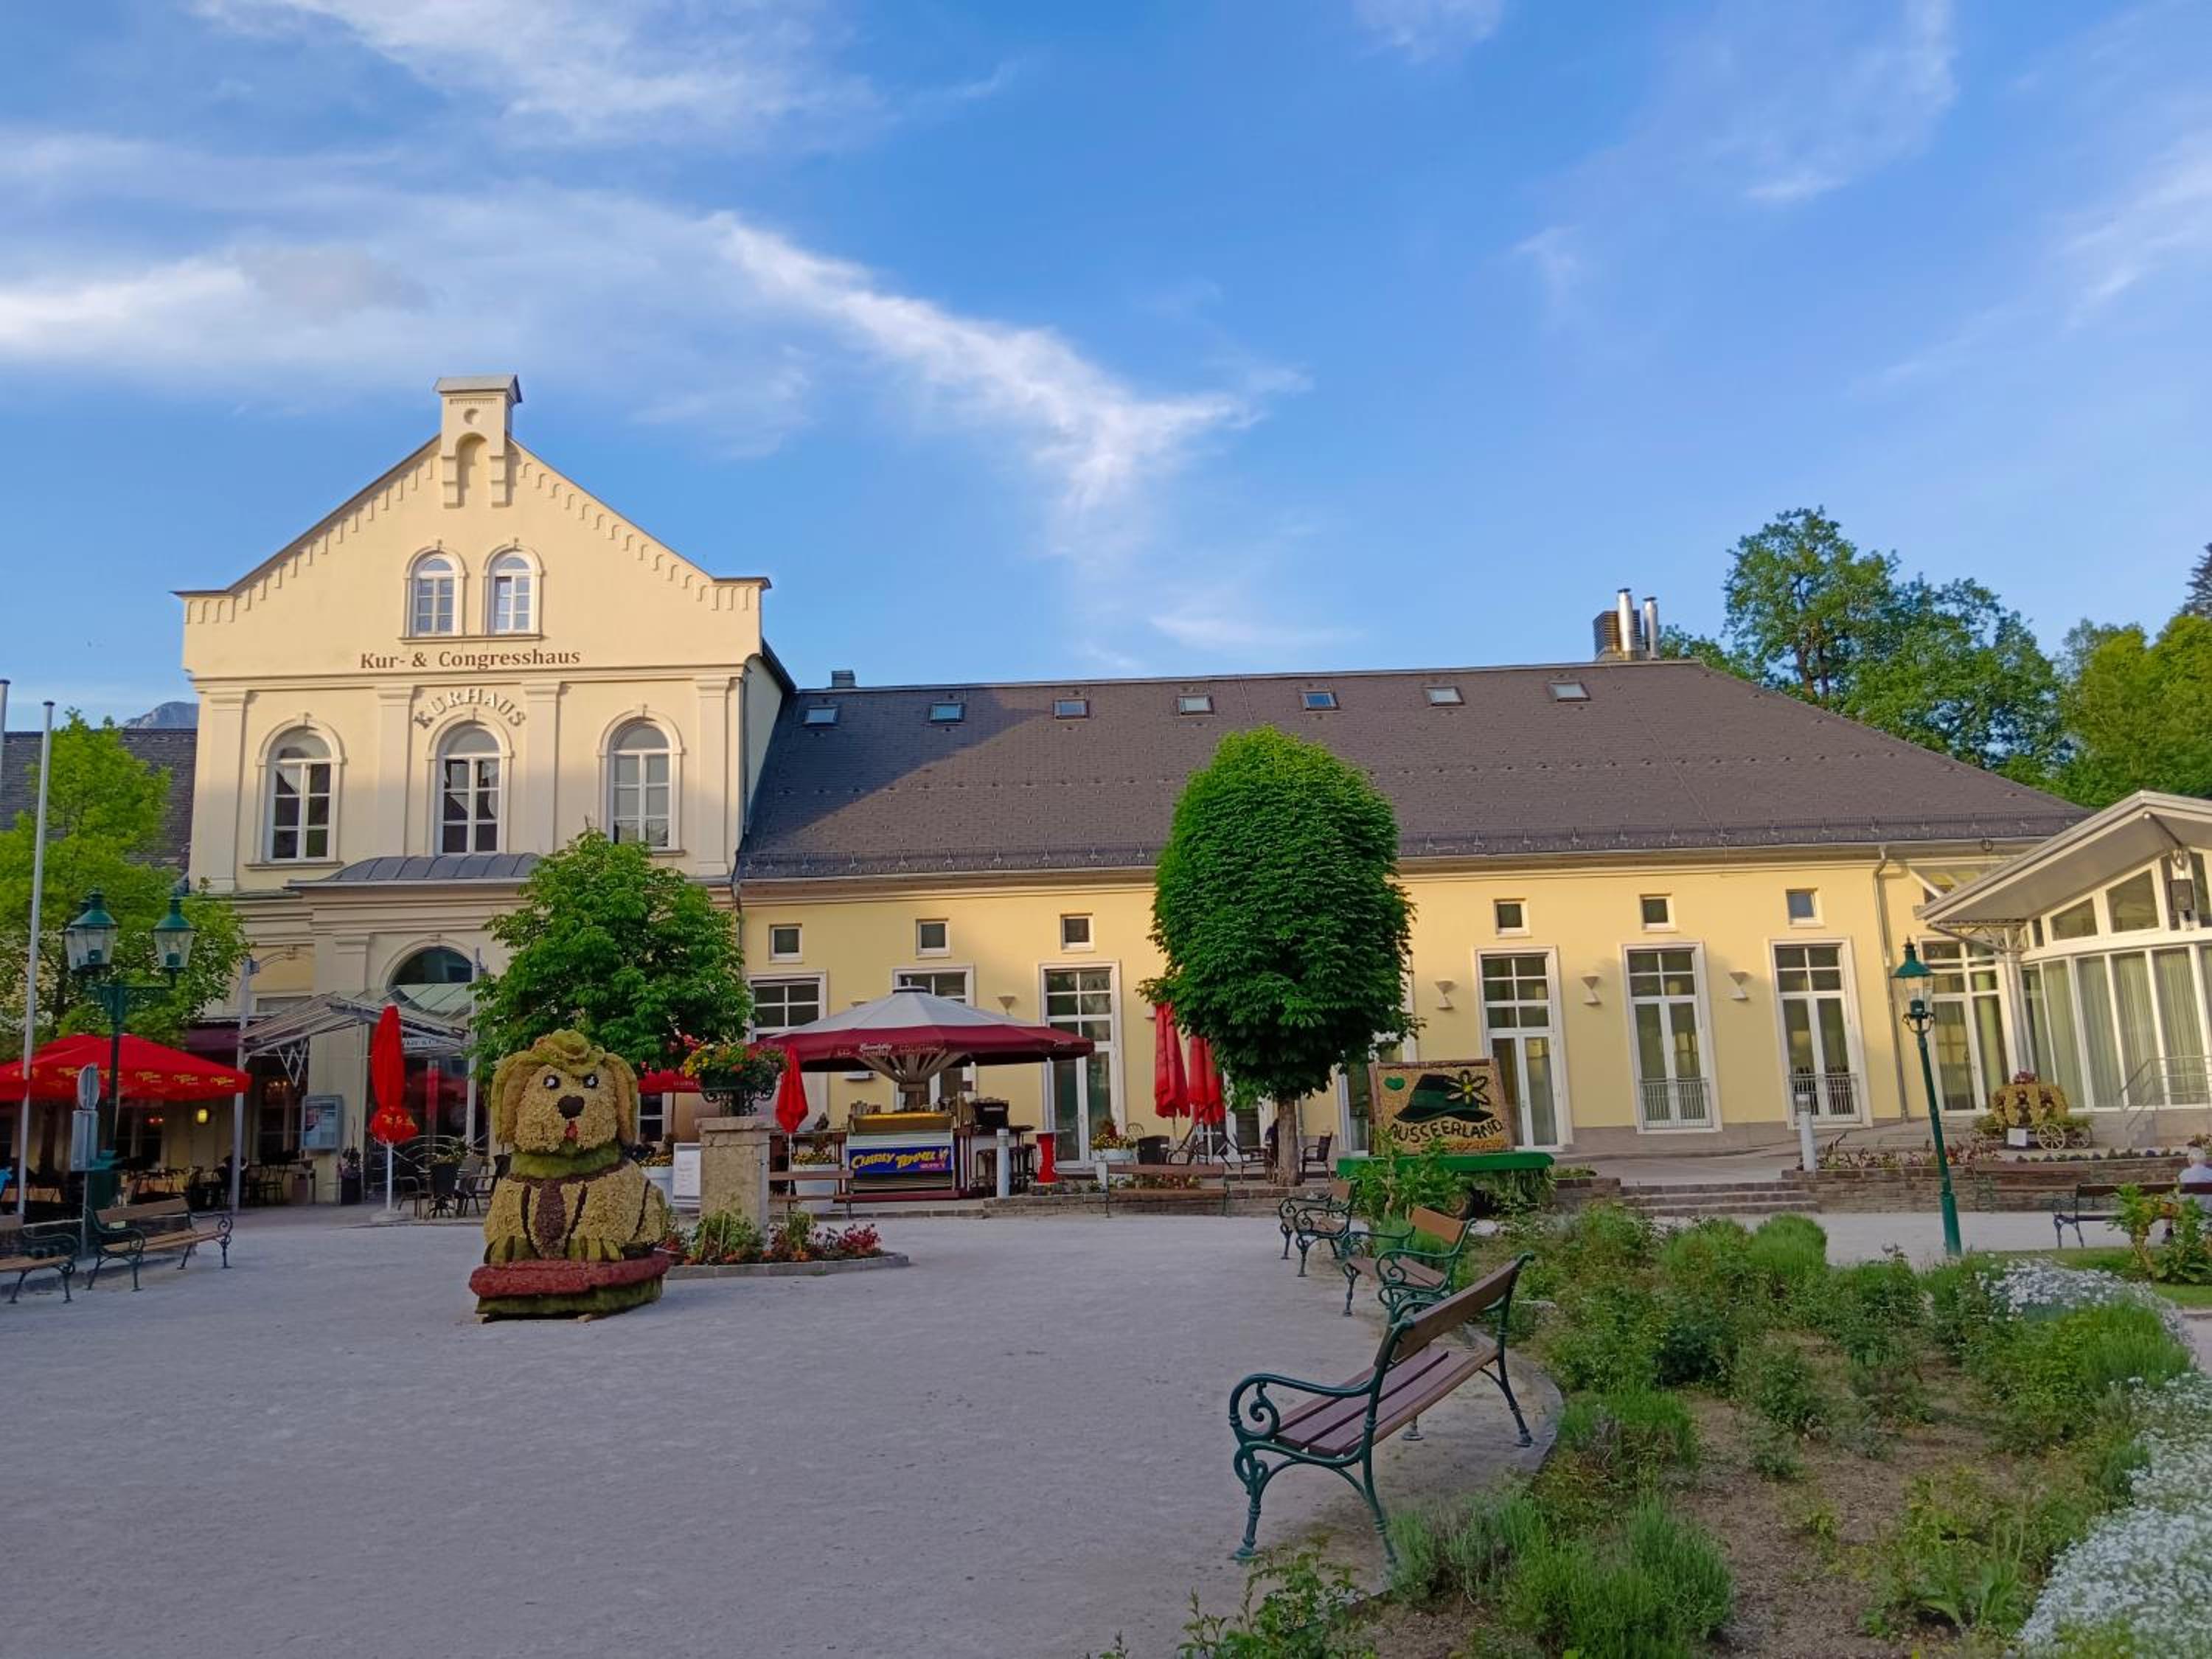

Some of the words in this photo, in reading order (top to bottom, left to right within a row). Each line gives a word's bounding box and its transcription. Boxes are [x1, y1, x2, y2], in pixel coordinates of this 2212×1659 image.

[361, 652, 406, 669] Kur-
[411, 651, 428, 667] &
[439, 648, 581, 670] Congresshaus
[413, 687, 526, 729] KURHAUS
[1389, 1118, 1503, 1144] AUSSEERLAND
